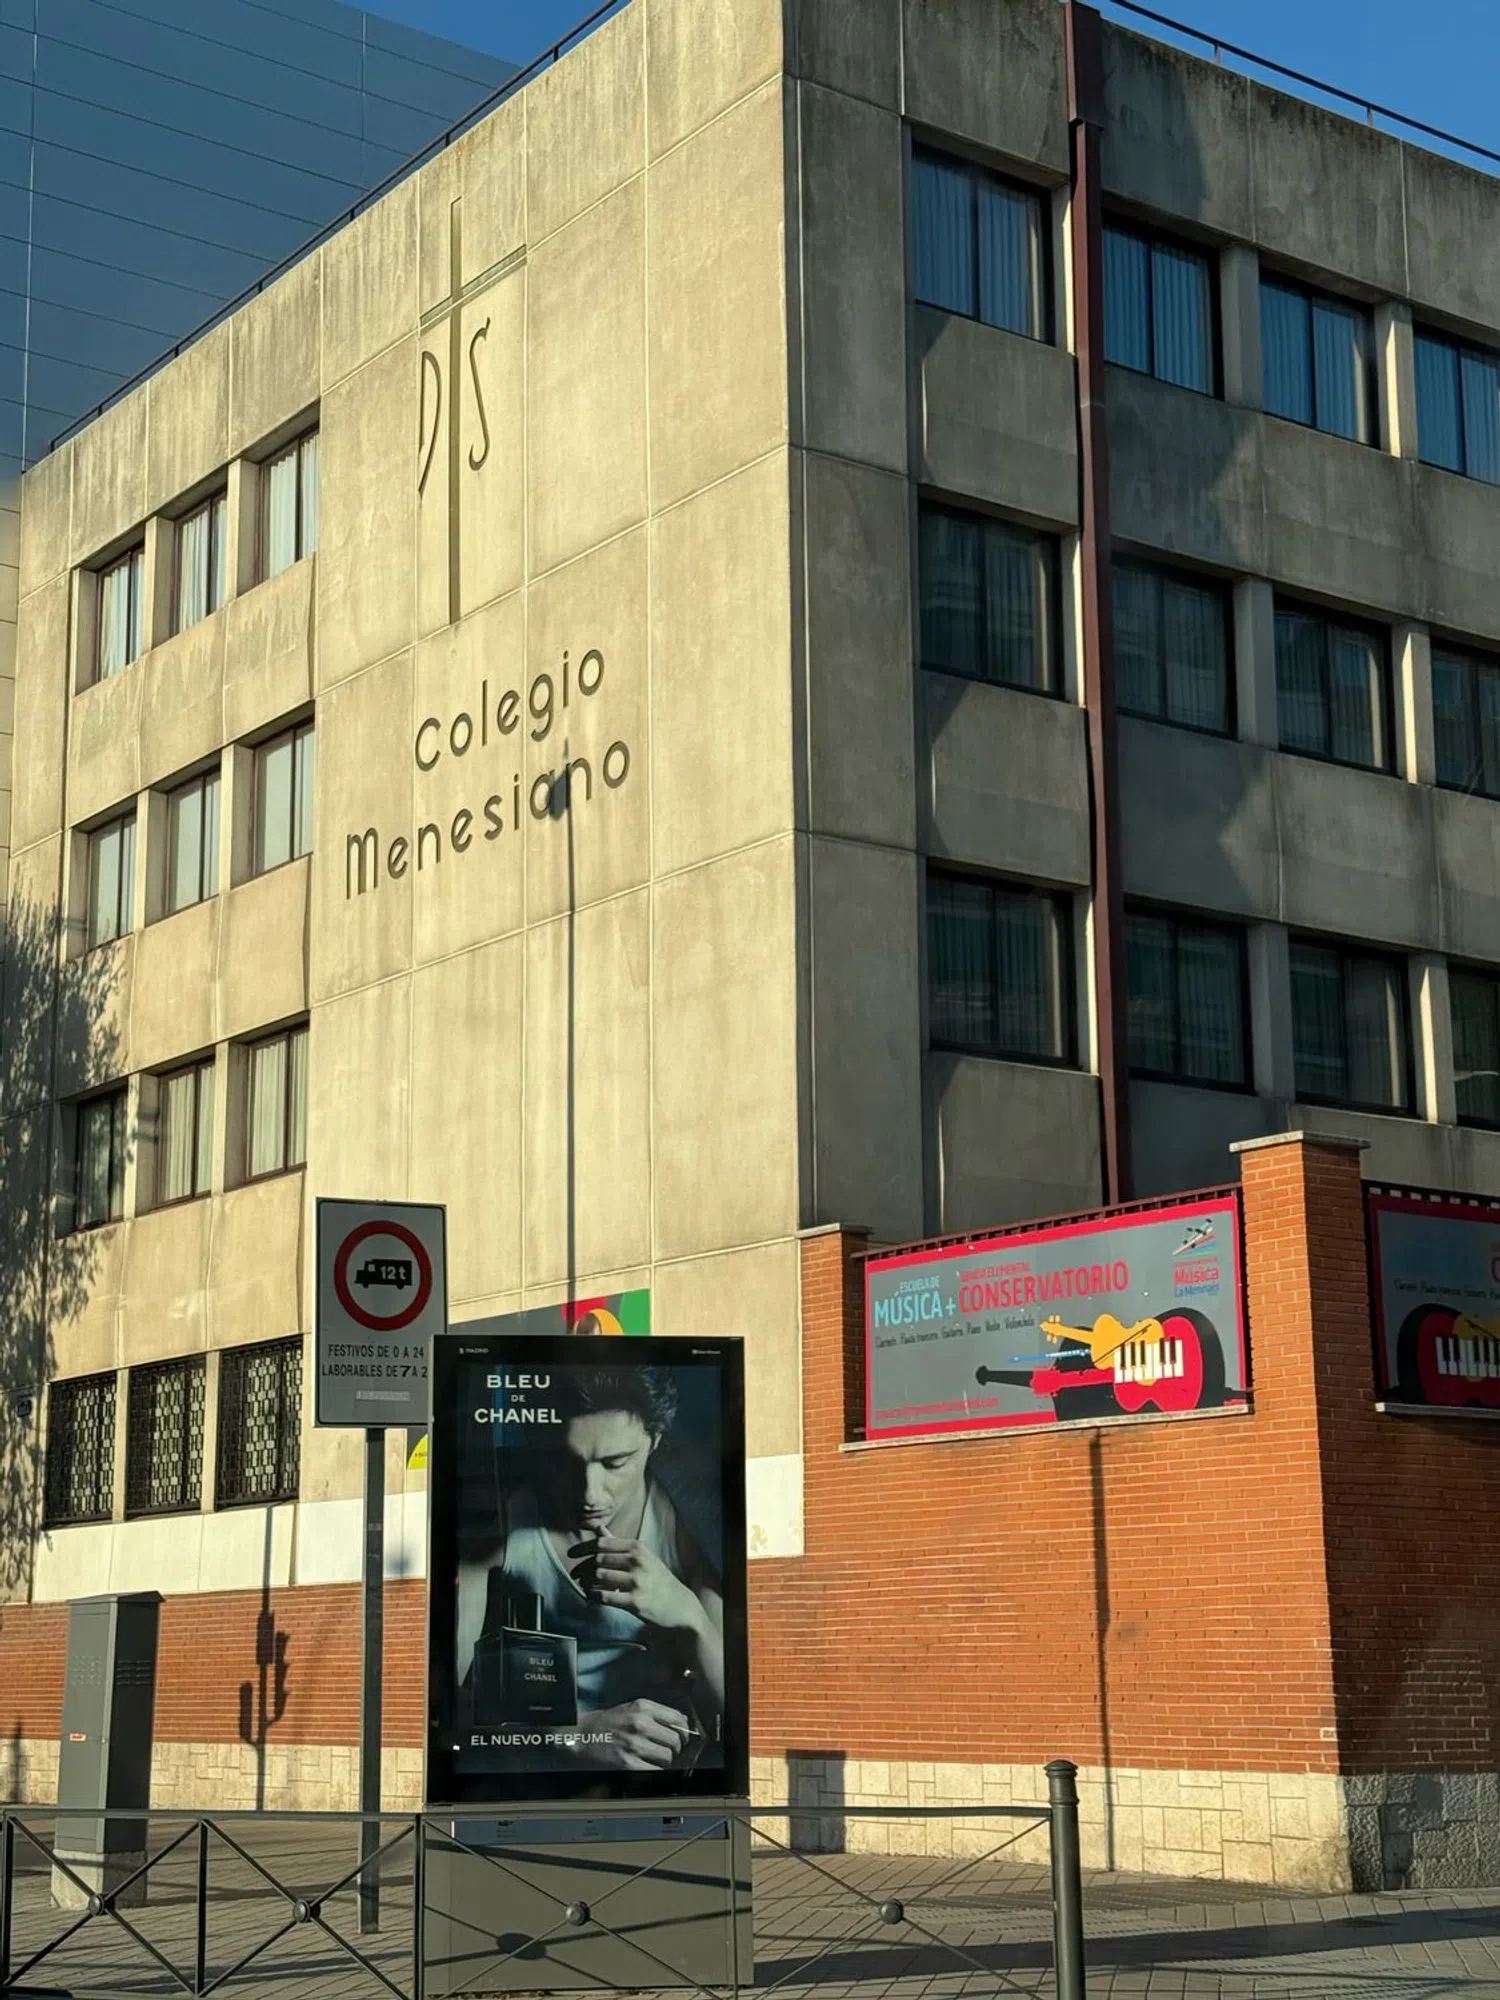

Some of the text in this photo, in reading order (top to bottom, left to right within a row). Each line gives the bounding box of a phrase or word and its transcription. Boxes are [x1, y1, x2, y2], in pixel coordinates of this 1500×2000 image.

[414, 648, 605, 771] Colegio
[900, 1277, 930, 1293] ESCUELA
[875, 1290, 943, 1328] MÚSICA
[959, 1261, 1129, 1313] CONSERVATORIO
[328, 1343, 374, 1358] FESTIVOS
[377, 1345, 389, 1358] DE
[403, 1345, 409, 1359] A
[413, 1346, 424, 1359] 24
[321, 1364, 382, 1377] LABORABLES
[386, 1365, 398, 1378] DE
[399, 1365, 411, 1378] 7
[411, 1366, 418, 1378] A
[486, 1374, 551, 1389] BLEU
[511, 1394, 526, 1402] DE
[474, 1408, 562, 1424] CHANEL
[529, 1656, 554, 1667] BLEU
[524, 1672, 557, 1682] CHANEL
[471, 1732, 613, 1746] EL NUEVO PERFUME
